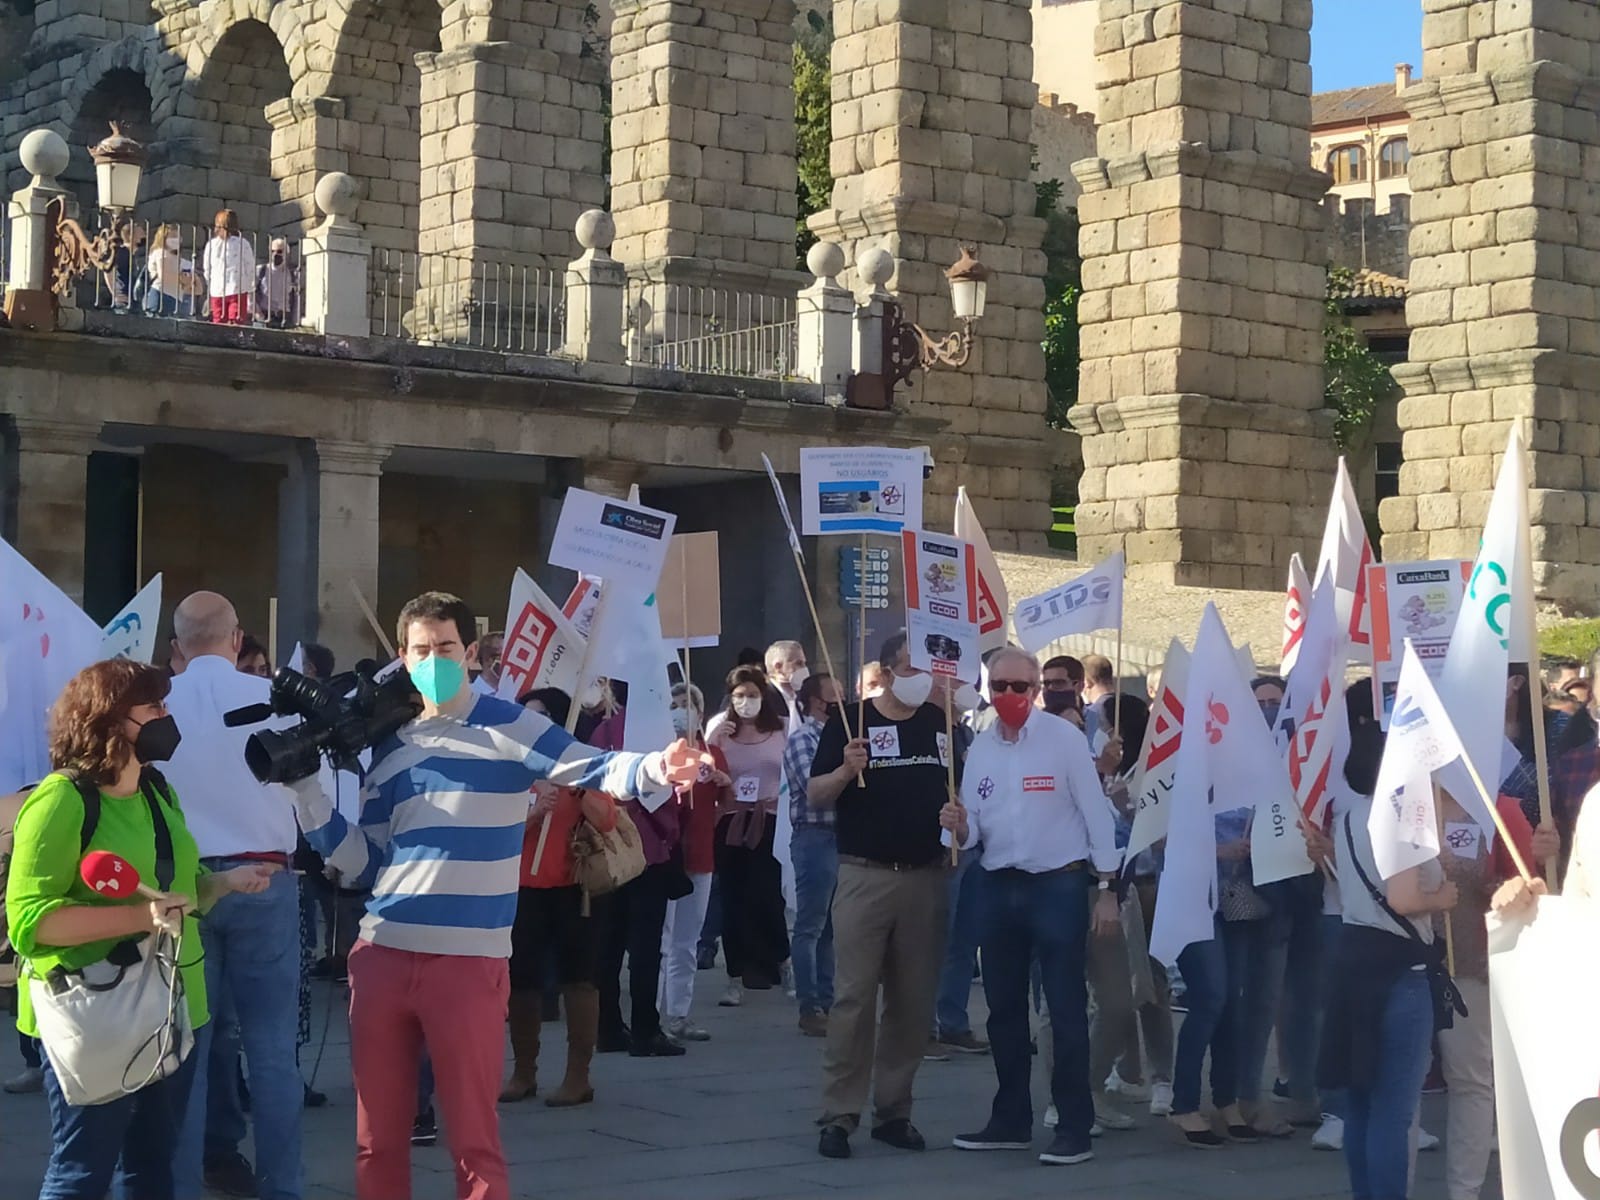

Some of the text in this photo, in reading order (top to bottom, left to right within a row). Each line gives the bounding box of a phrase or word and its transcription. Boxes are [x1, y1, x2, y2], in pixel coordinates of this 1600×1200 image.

[1399, 571, 1447, 582] CaixaBank
[930, 605, 957, 617] CCOO
[1271, 802, 1286, 837] eón
